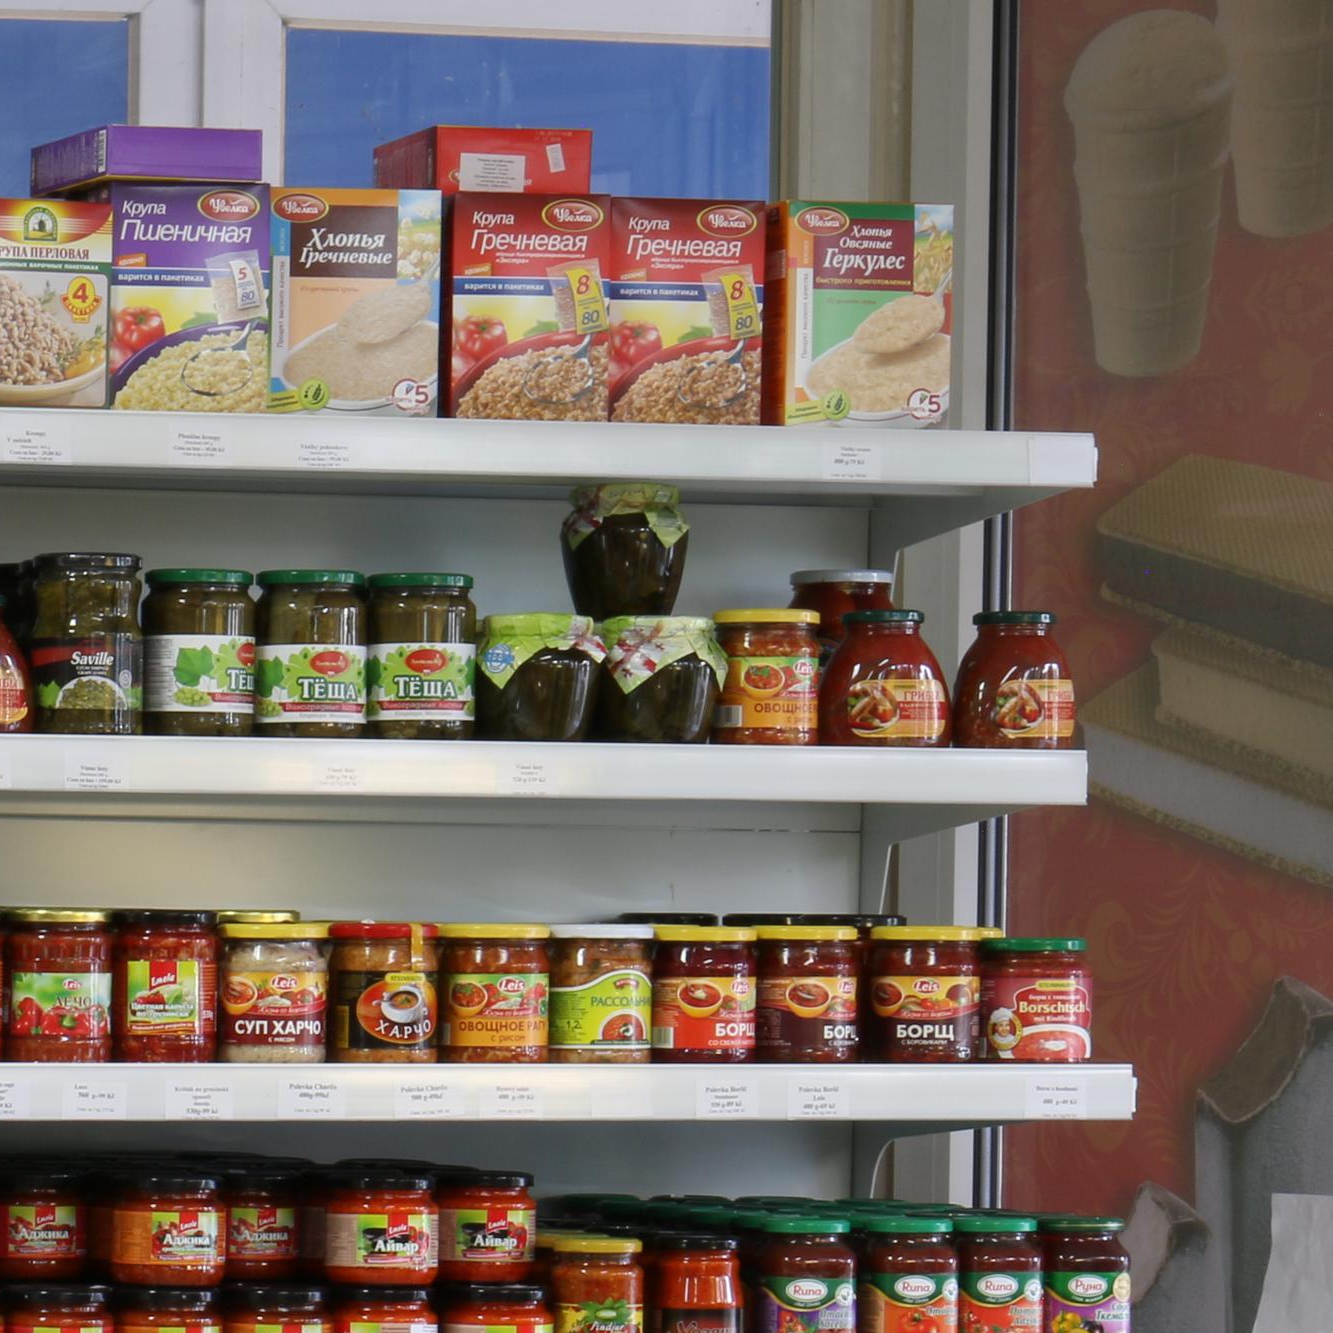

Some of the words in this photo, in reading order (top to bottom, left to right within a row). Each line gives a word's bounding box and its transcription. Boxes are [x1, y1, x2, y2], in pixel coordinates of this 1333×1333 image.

[121, 218, 251, 244] Пшеничная
[839, 237, 892, 249] Овсяные
[28, 246, 90, 259] ПЕРЛОВАЯ
[823, 246, 905, 273] Геркулес
[70, 651, 114, 666] Saville
[297, 676, 357, 700] ТЁЩА
[272, 976, 297, 990] Leis
[1018, 1000, 1086, 1013] Borschtsch
[234, 1019, 269, 1035] СУП
[273, 1019, 321, 1035] ХАРЧО
[896, 1024, 955, 1042] БОРЩ
[474, 1233, 517, 1250] Айвар
[792, 1285, 823, 1297] Runa
[1075, 1279, 1108, 1295] Руна
